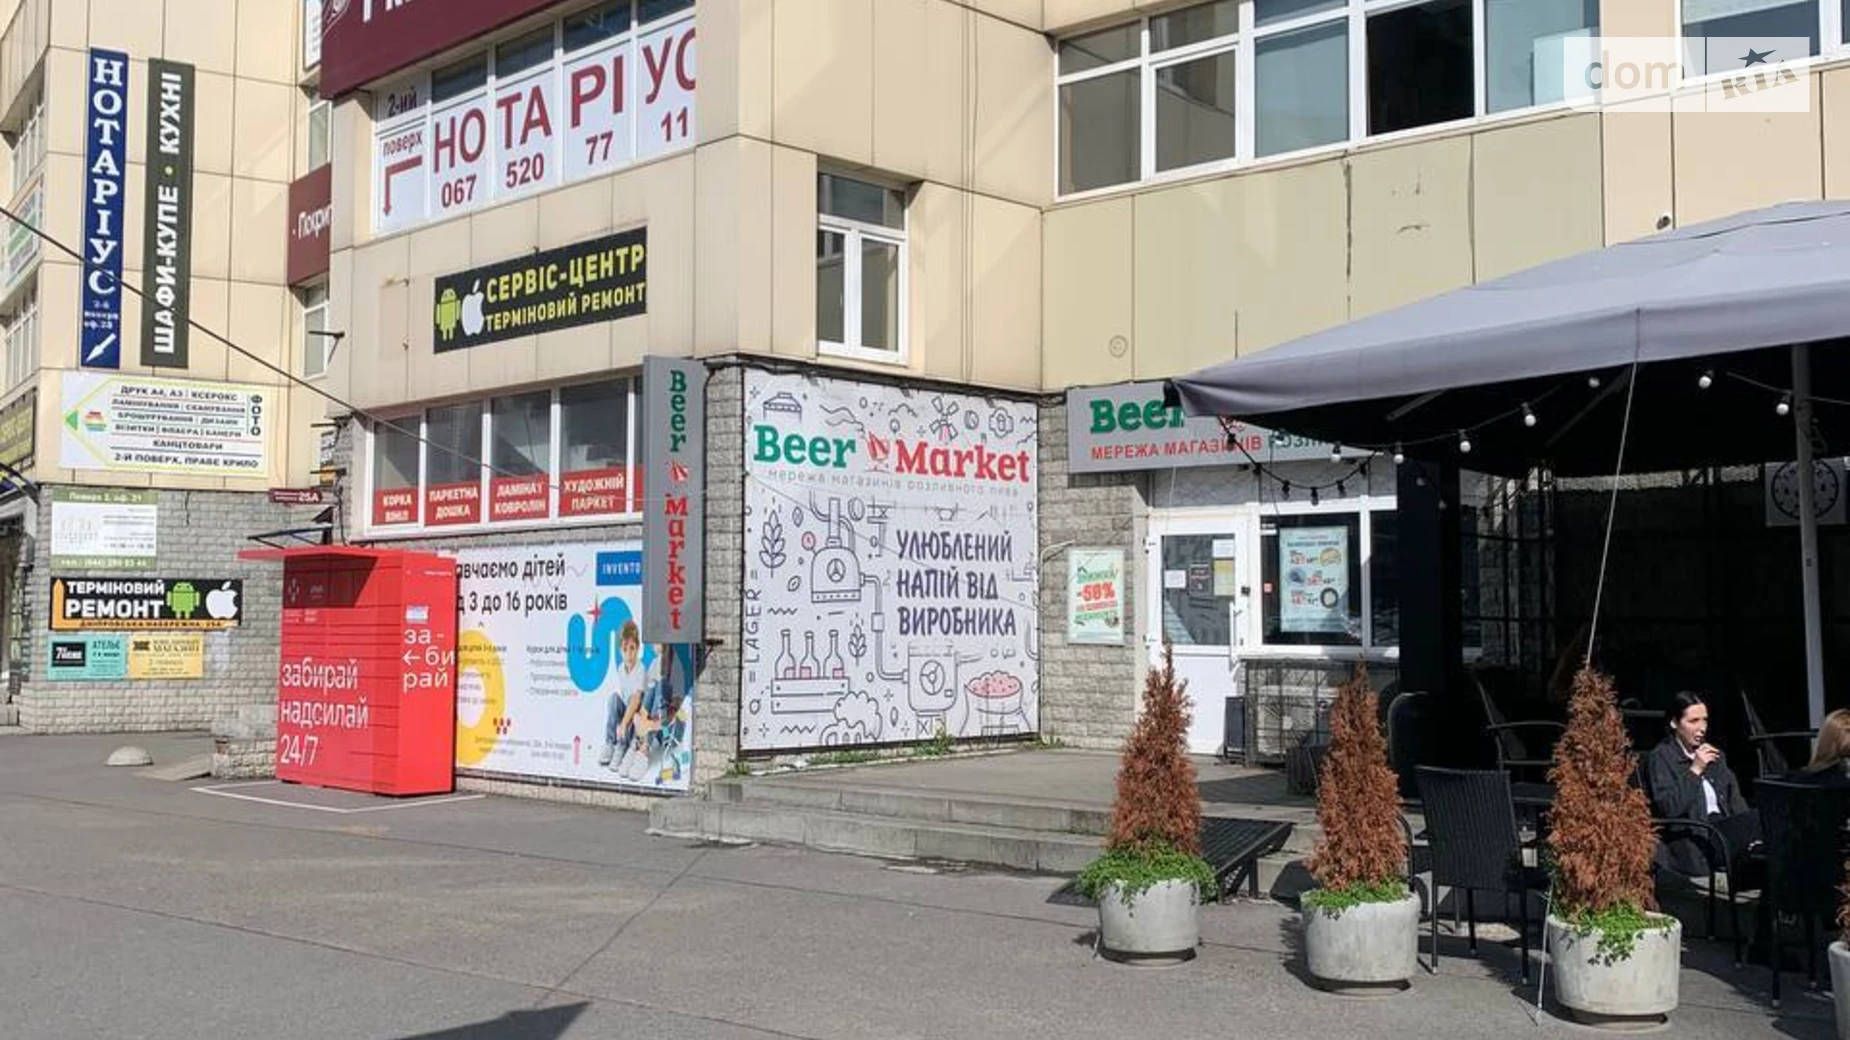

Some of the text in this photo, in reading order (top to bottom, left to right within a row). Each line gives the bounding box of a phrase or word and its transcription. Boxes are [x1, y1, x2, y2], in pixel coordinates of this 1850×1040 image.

[383, 130, 423, 157] поверх
[441, 106, 689, 208] 067 520 77 11
[88, 58, 124, 295] НОТАРІУС
[154, 72, 182, 354] ШАФИ-КУПЕ КУХНІ
[486, 244, 645, 303] СЕРВІС-ЦЕНТР
[486, 282, 645, 332] ТЕРМІНОВИЙ РЕМОНТ
[120, 385, 148, 395] ДРУК
[191, 389, 238, 400] КСЕРОКС
[670, 370, 687, 453] Beer
[153, 439, 223, 451] КАНЦТОВАРИ
[753, 424, 1030, 482] Beer Market
[1091, 444, 1159, 460] МЕРЕЖА
[184, 456, 220, 467] ПРАВЕ
[223, 459, 259, 469] КРИЛО
[429, 484, 479, 502] ПАРКЕТНА
[496, 482, 543, 497] ЛАМІНАТ
[563, 473, 625, 494] ХУДОЖНІЙ
[768, 470, 826, 483] мережа
[831, 475, 902, 490] магазинів
[383, 494, 413, 507] КОРКА
[435, 503, 471, 520] ДОШКА
[494, 500, 546, 515] КОВРОЛІН
[571, 495, 615, 510] ПАРКЕТ
[896, 530, 1012, 562] УЛЮБЛЕНИЙ
[522, 552, 566, 581] дітей
[664, 495, 688, 631] Market
[67, 579, 165, 595] ТЕРМІНОВИЙ
[896, 566, 999, 600] НАПІЙ ВІД
[65, 599, 164, 618] РЕМОНТ
[469, 594, 479, 611] 3
[481, 595, 501, 614] до
[505, 593, 521, 611] 16
[525, 587, 568, 617] років
[745, 589, 761, 663] LAGER
[898, 606, 1017, 637] ВИРОБНИКА
[425, 646, 455, 665] би
[282, 657, 359, 694] забирай
[402, 667, 448, 693] рай
[281, 696, 369, 729] надсилай
[281, 734, 319, 767] 24/7
